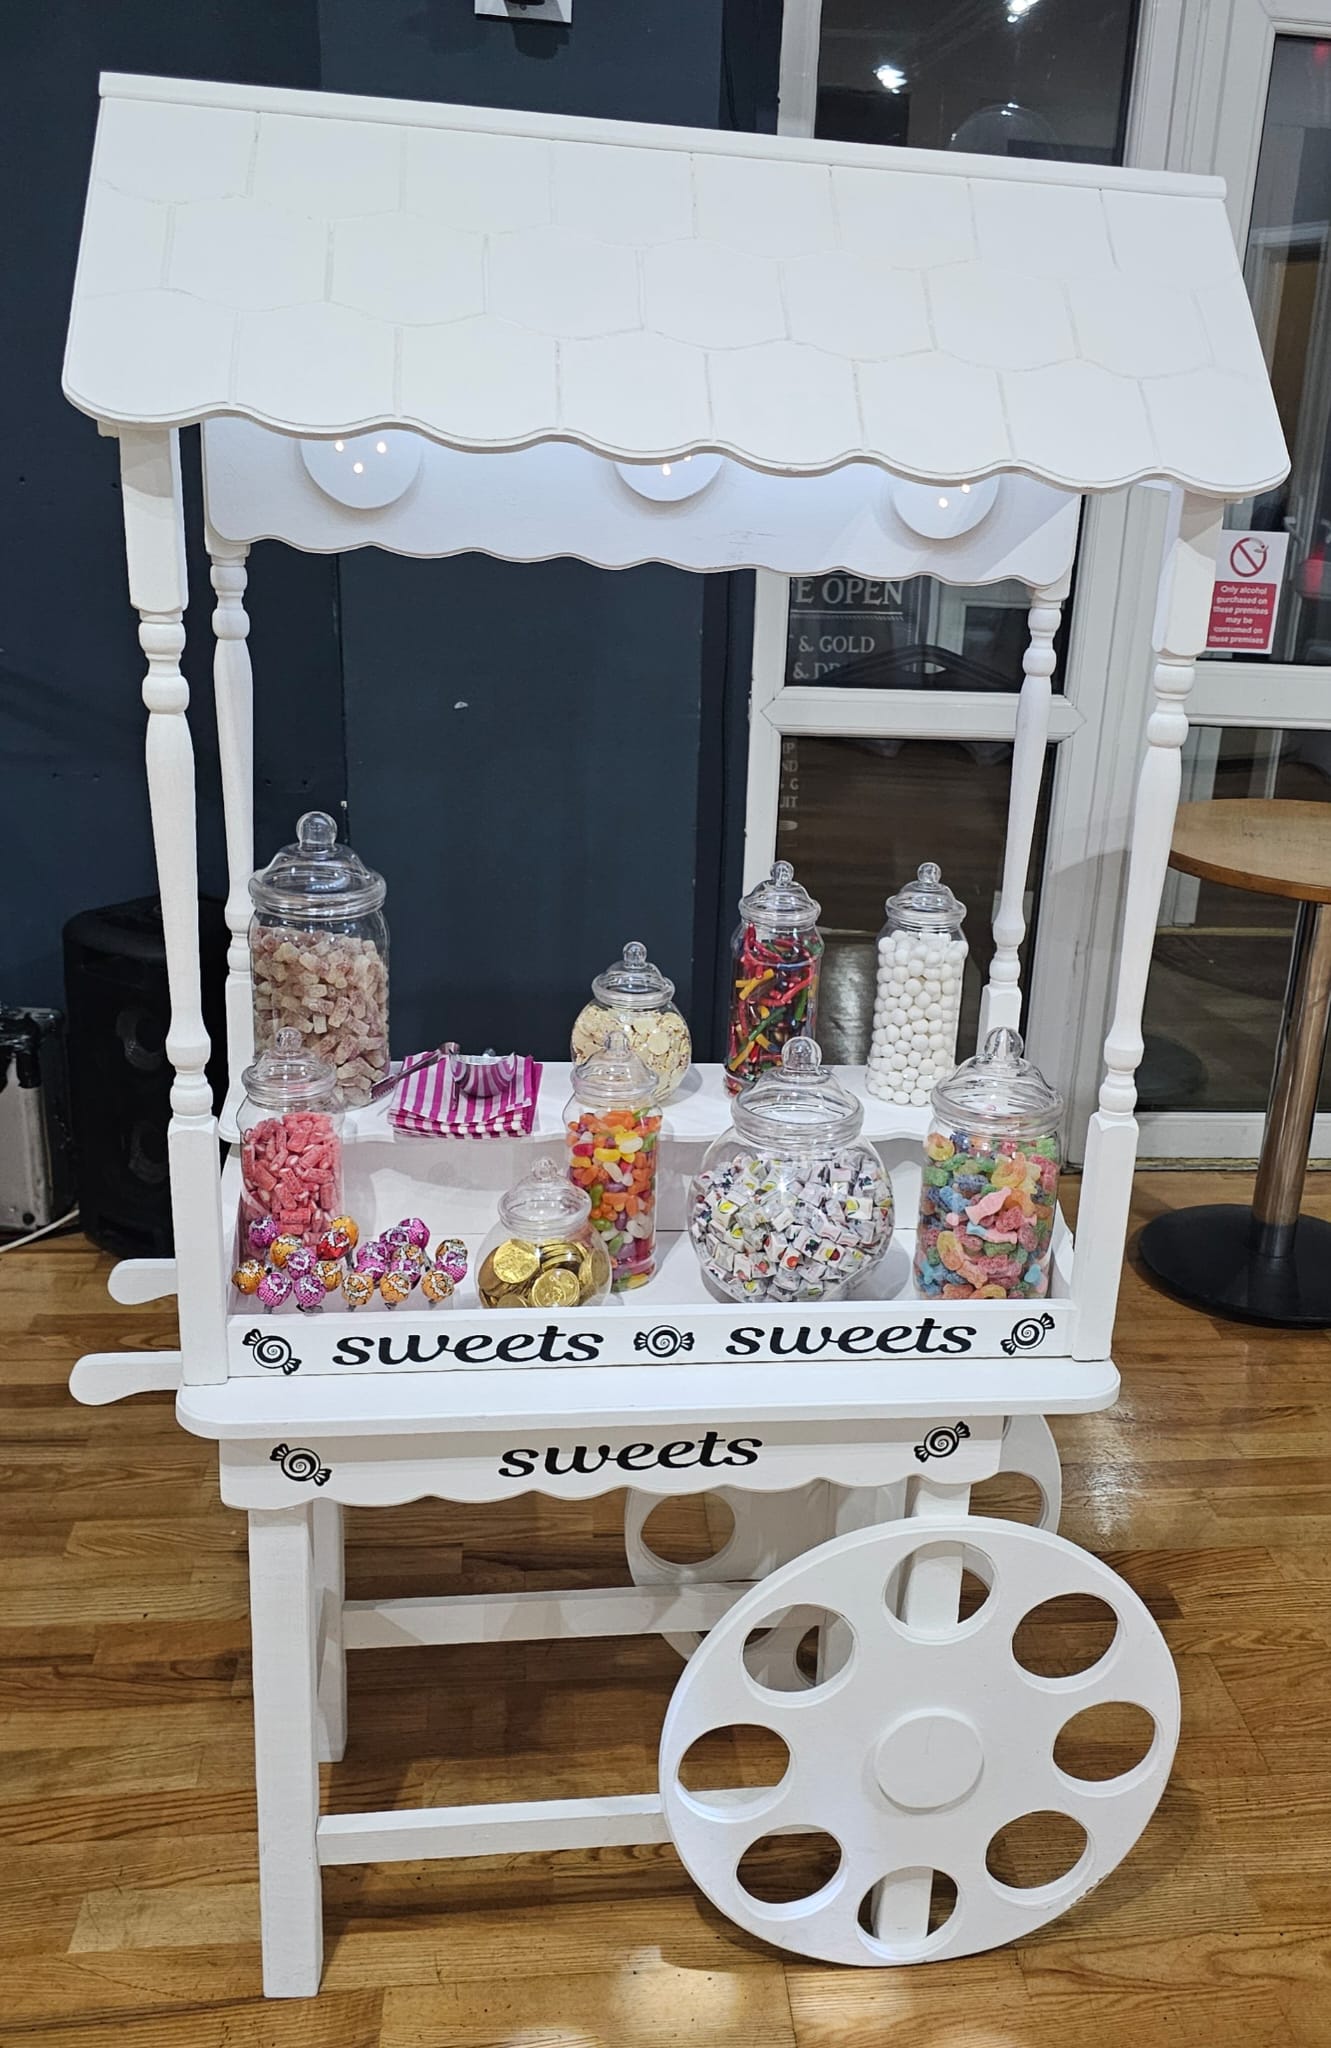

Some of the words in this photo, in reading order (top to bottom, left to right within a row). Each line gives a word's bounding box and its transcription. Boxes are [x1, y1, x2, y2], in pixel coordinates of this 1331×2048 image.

[822, 578, 905, 605] OPEN
[1220, 585, 1238, 594] Only
[1240, 586, 1267, 594] alcohol
[1216, 596, 1256, 604] purchased
[1213, 606, 1234, 614] these
[1233, 607, 1269, 615] premises
[1243, 616, 1253, 624] be
[1213, 626, 1252, 634] consumed
[799, 635, 814, 652] &
[820, 635, 875, 653] GOLD
[1229, 636, 1264, 644] premises
[793, 662, 809, 679] &
[332, 1325, 604, 1366] sweets
[725, 1317, 977, 1356] sweets
[498, 1431, 763, 1478] sweets
